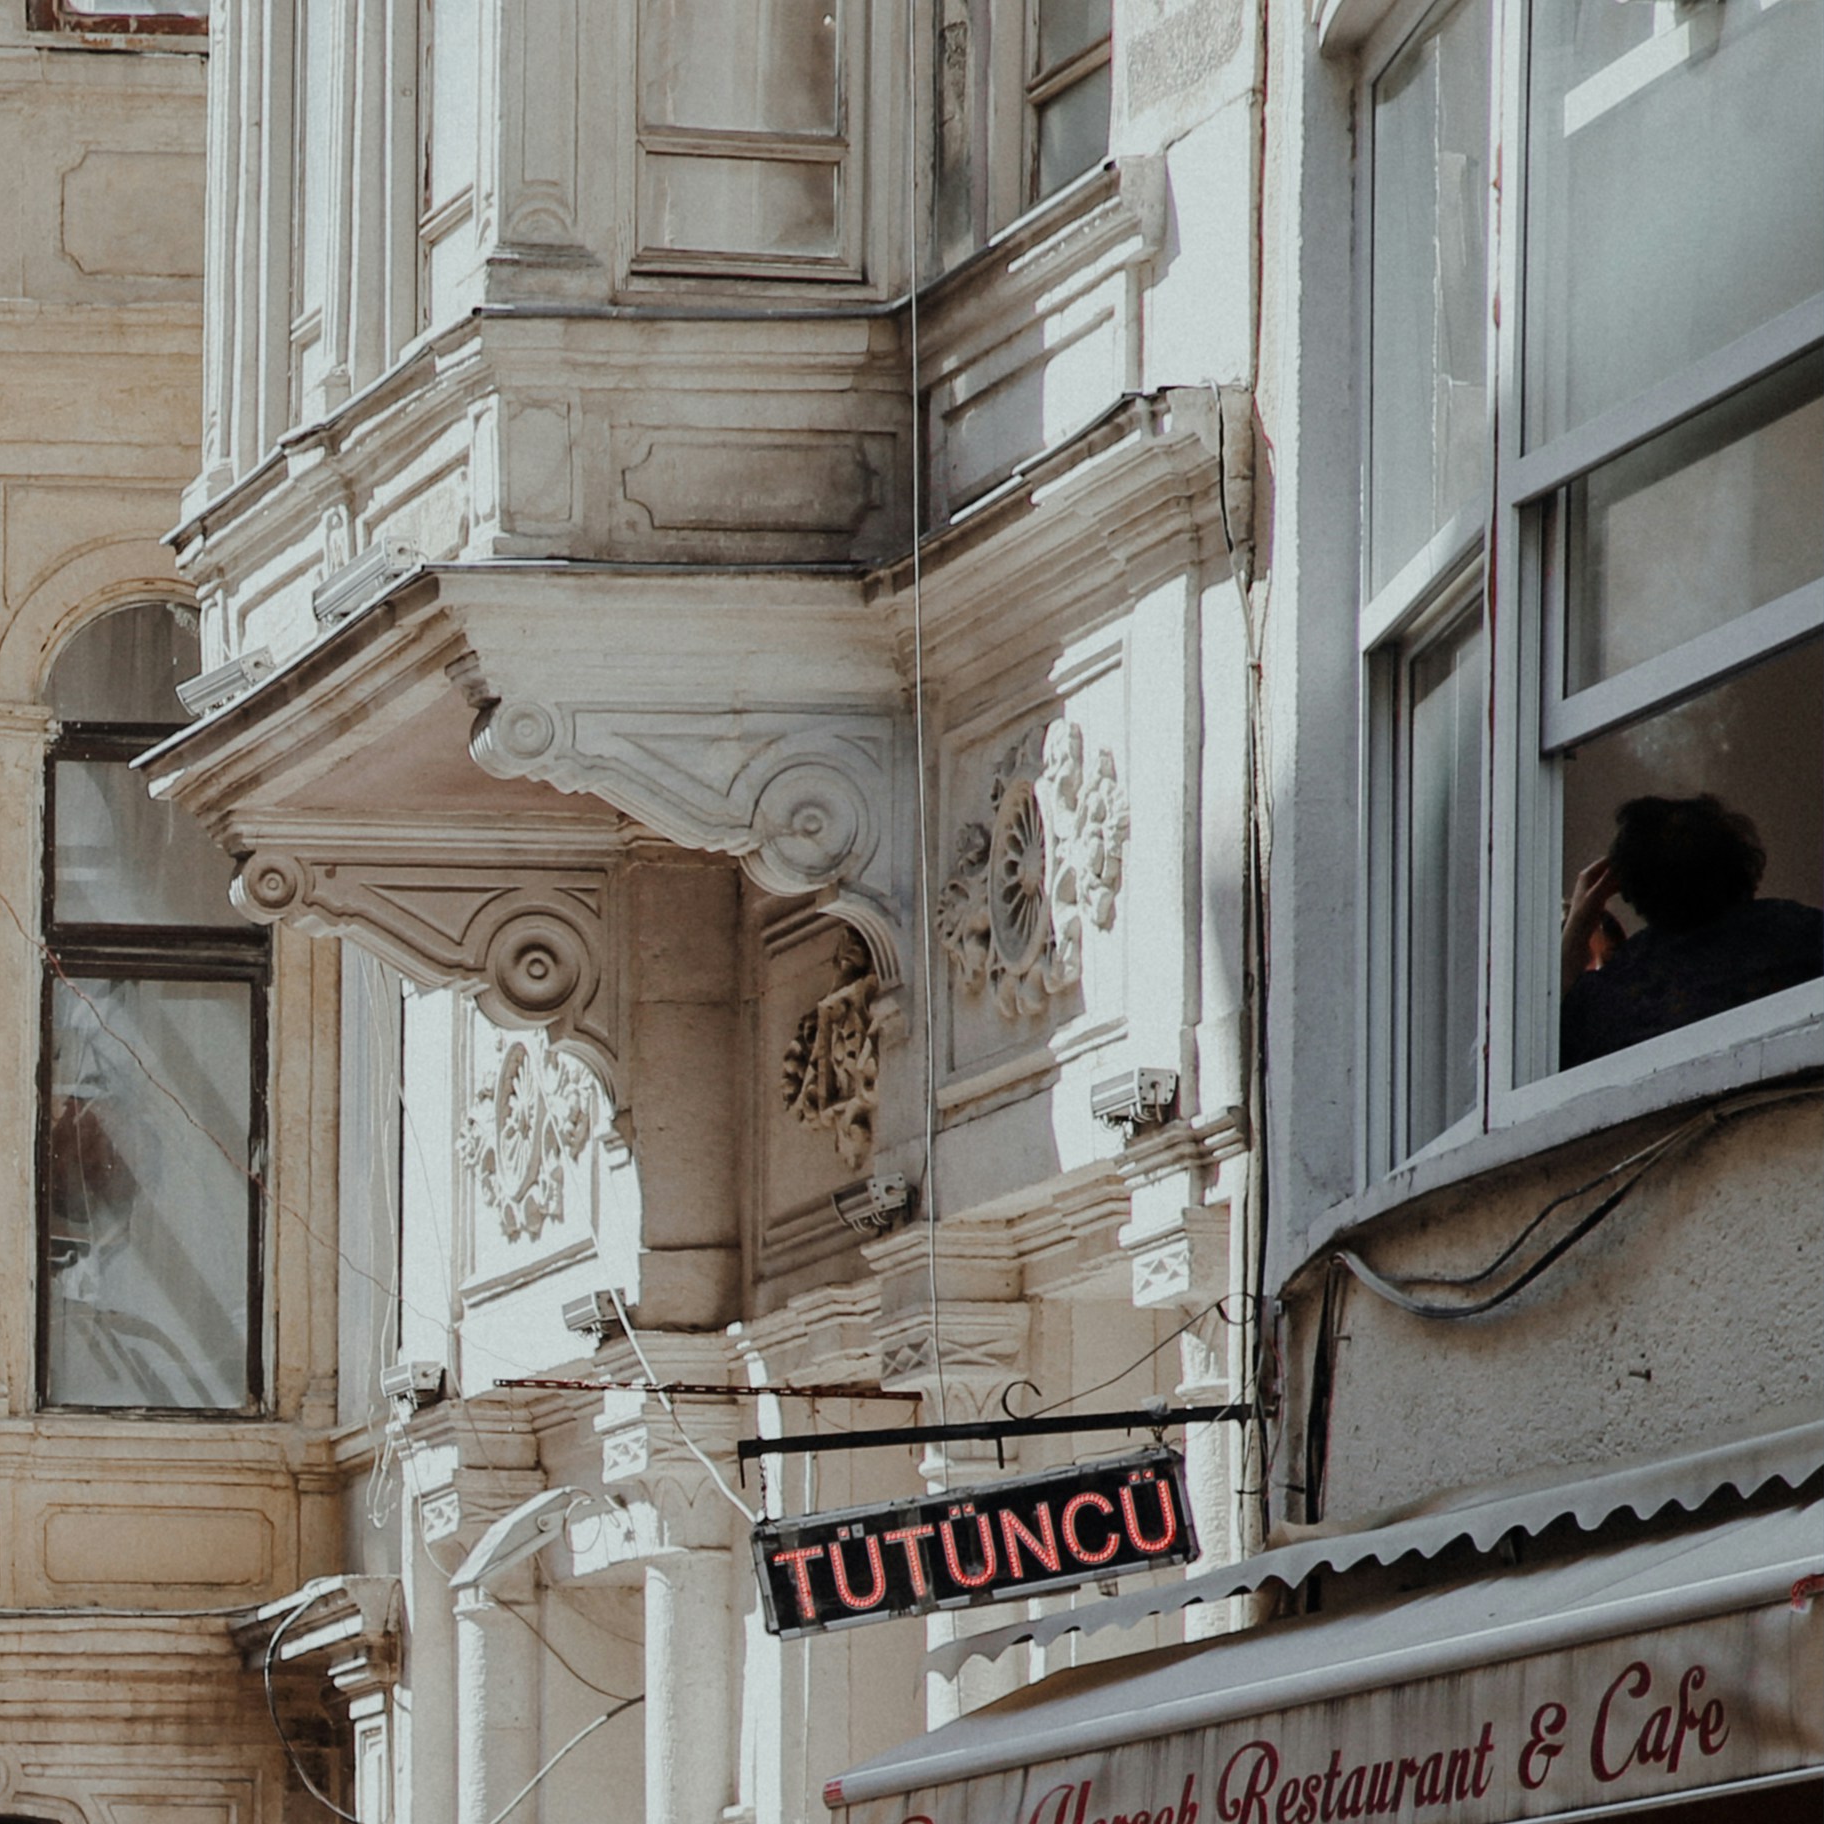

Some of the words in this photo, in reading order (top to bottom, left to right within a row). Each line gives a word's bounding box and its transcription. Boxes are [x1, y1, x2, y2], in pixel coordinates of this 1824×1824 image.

[773, 1471, 1177, 1619] TÜTÜNCÜ
[1520, 1701, 1568, 1789] &
[1590, 1660, 1731, 1782] Cafe
